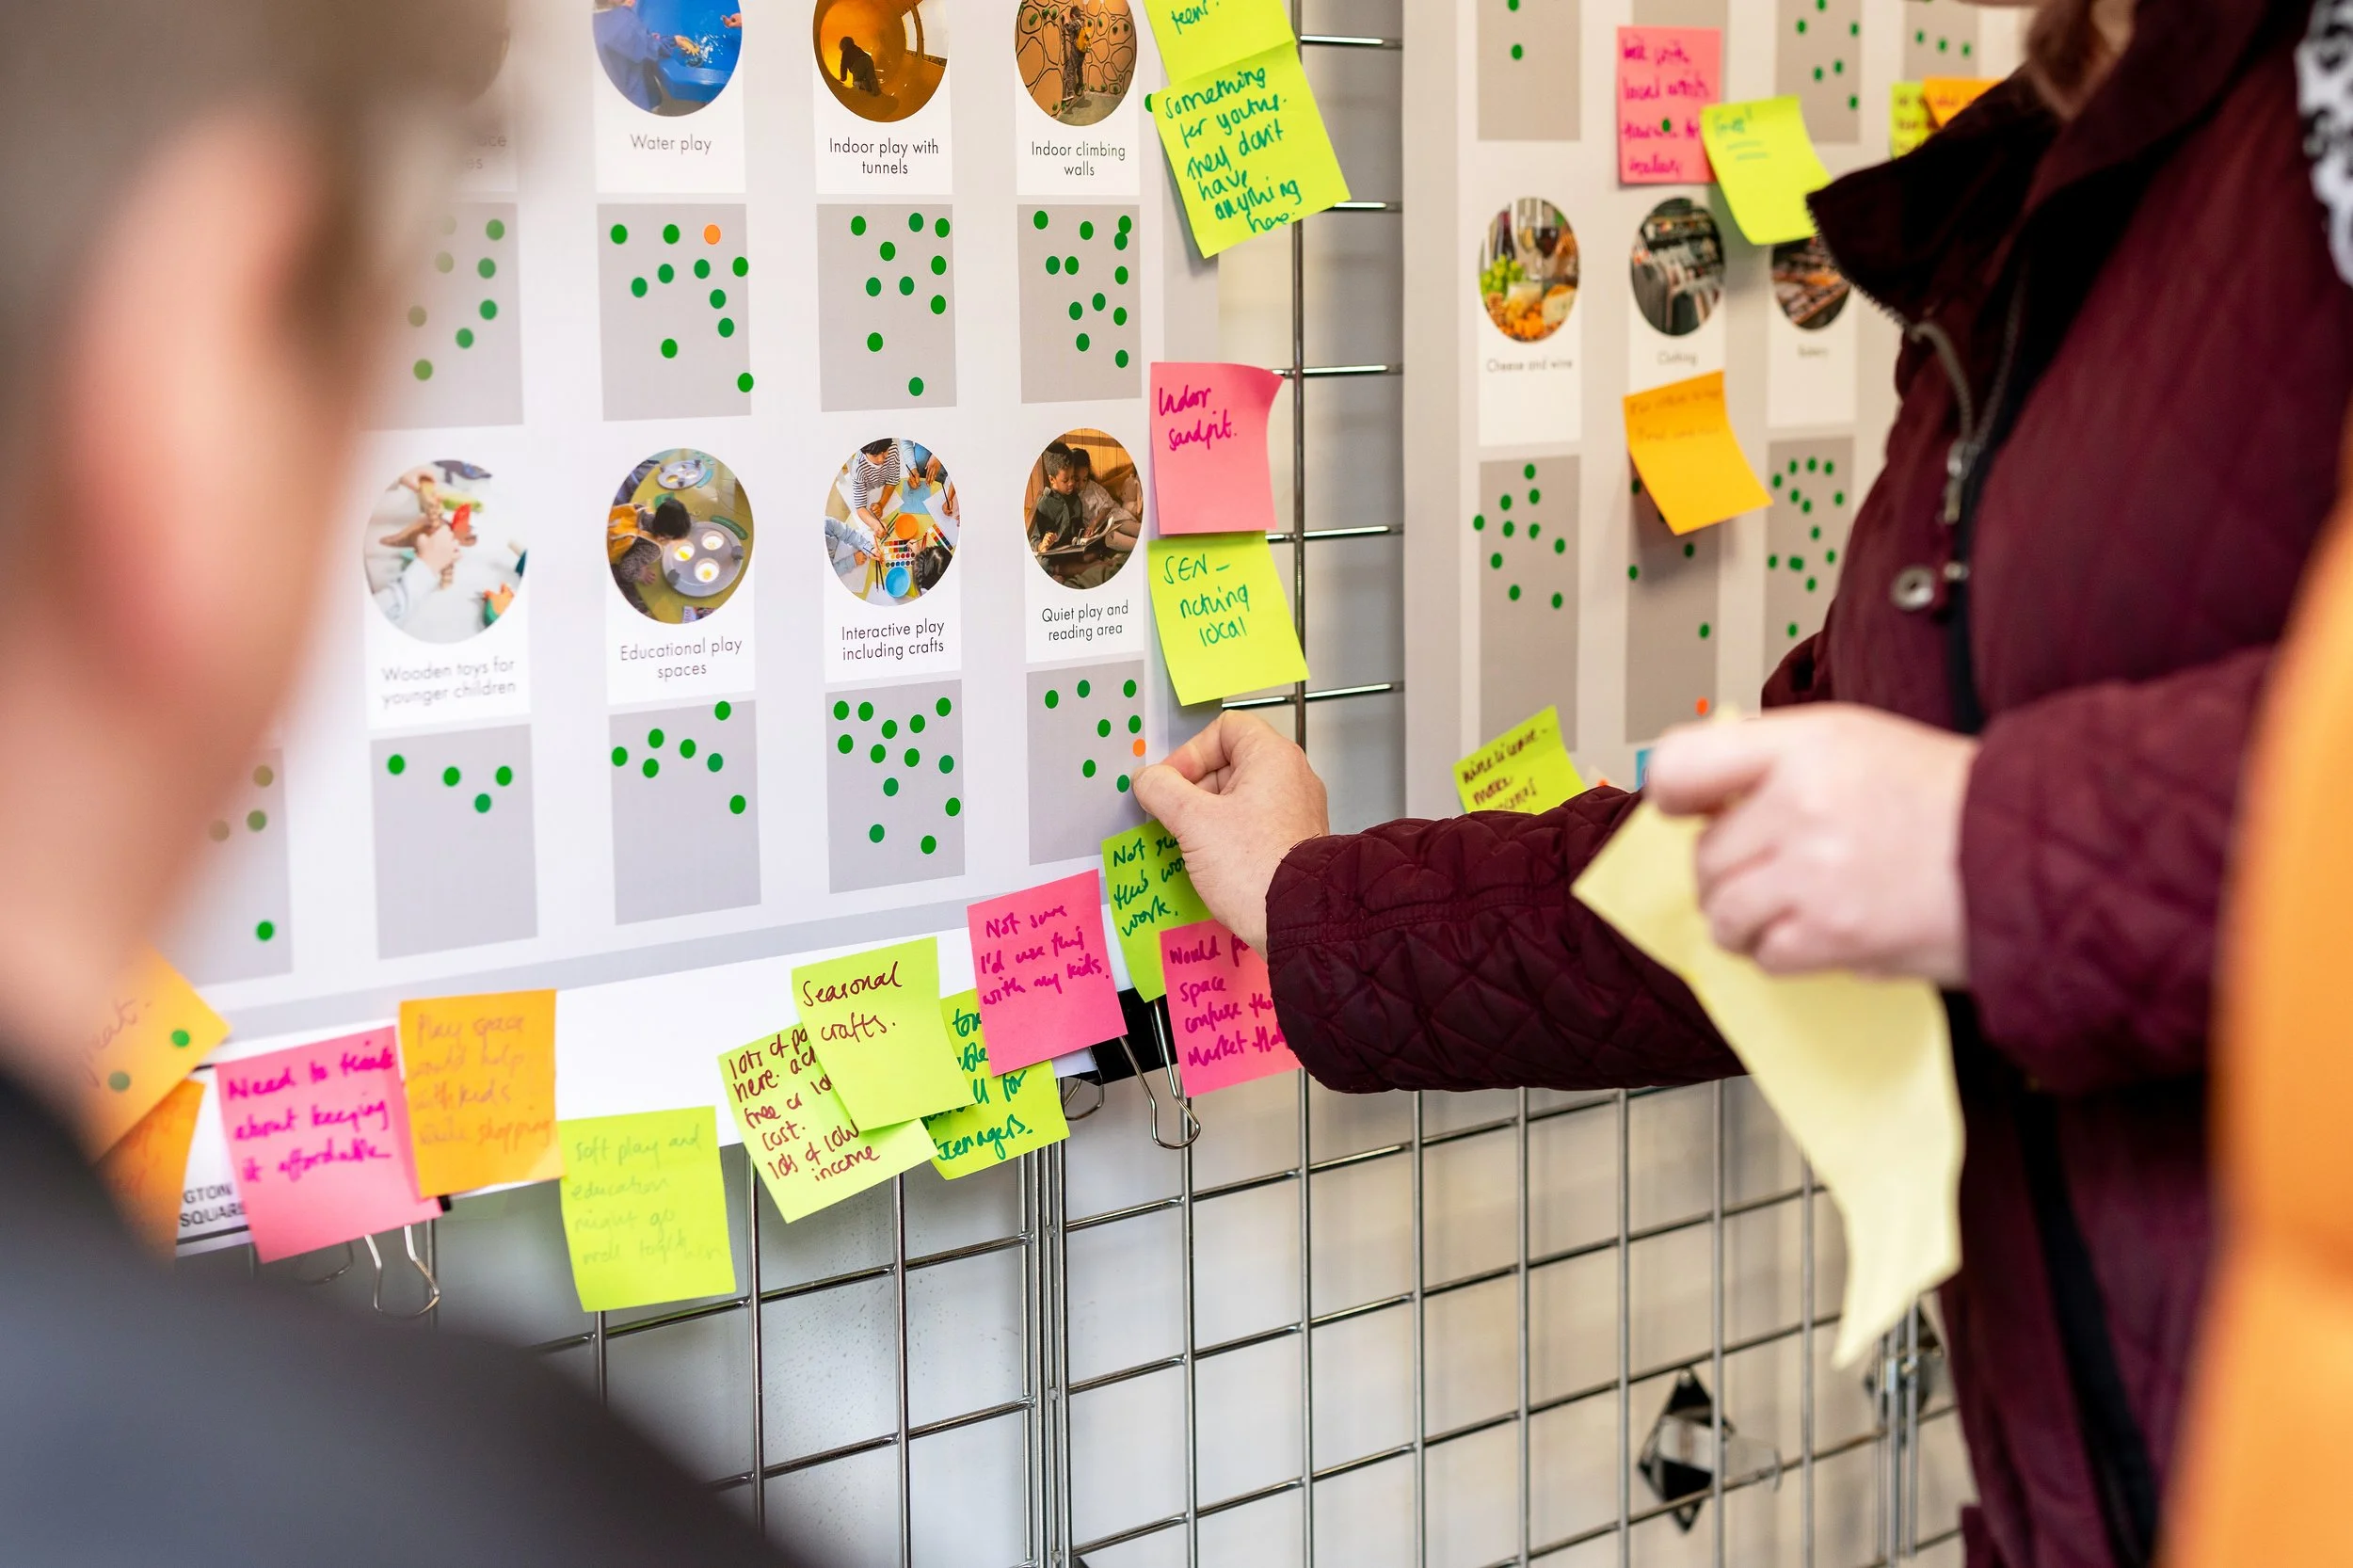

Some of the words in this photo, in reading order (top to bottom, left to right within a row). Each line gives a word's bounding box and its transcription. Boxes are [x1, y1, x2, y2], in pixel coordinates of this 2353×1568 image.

[630, 134, 676, 152] Water
[680, 134, 712, 154] play
[829, 137, 874, 155] Indoor
[879, 137, 908, 158] play
[912, 138, 939, 155] with
[1032, 140, 1072, 156] Indoor
[1076, 141, 1126, 161] climbing
[861, 158, 909, 175] tunnels
[1064, 161, 1096, 177] walls
[1199, 169, 1247, 201] have
[1214, 176, 1303, 220] anything
[1487, 358, 1525, 373] Cheese
[1529, 357, 1548, 371] and
[1551, 360, 1573, 370] wine
[1163, 553, 1208, 584] SEN
[1042, 607, 1075, 624] Quiet
[1078, 603, 1103, 622] play
[1107, 600, 1129, 616] and
[1179, 584, 1250, 619] nothing
[841, 622, 911, 642] Interactive
[916, 617, 945, 637] play
[1048, 623, 1093, 642] reading
[1097, 623, 1124, 638] area
[1199, 616, 1248, 647] local
[620, 638, 707, 662] Educational
[712, 635, 743, 656] play
[842, 641, 904, 661] including
[908, 639, 945, 656] crafts
[381, 664, 452, 683] Wooden
[456, 661, 488, 680] toys
[493, 656, 516, 674] for
[658, 662, 707, 681] spaces
[381, 685, 450, 709] younger
[454, 679, 517, 700] children
[1112, 837, 1145, 867] Not
[985, 912, 1020, 938] Not
[1030, 904, 1067, 929] sure
[1122, 895, 1179, 936] work.
[980, 950, 1004, 974] I'd
[1051, 926, 1084, 957] this
[1169, 935, 1222, 966] Would
[803, 961, 903, 1007] Seasonal
[983, 976, 1026, 1005] with
[1033, 973, 1063, 994] my
[821, 1012, 896, 1043] crafts.
[1185, 1001, 1242, 1033] confuse
[482, 1043, 524, 1078] help
[769, 1033, 791, 1059] of
[229, 1066, 296, 1100] Need
[310, 1062, 328, 1082] to
[340, 1040, 394, 1077] think
[809, 1073, 833, 1096] lo
[458, 1079, 512, 1109] kids
[234, 1108, 297, 1141] about
[312, 1090, 389, 1132] keeping
[476, 1104, 552, 1154] shopping
[618, 1135, 660, 1170] play
[668, 1123, 702, 1151] and
[762, 1120, 806, 1151] cost.
[244, 1157, 262, 1182] it
[278, 1137, 392, 1183] affordable
[814, 1145, 881, 1182] income
[183, 1182, 232, 1204] GTON
[570, 1176, 672, 1200] education
[649, 1208, 677, 1240] go
